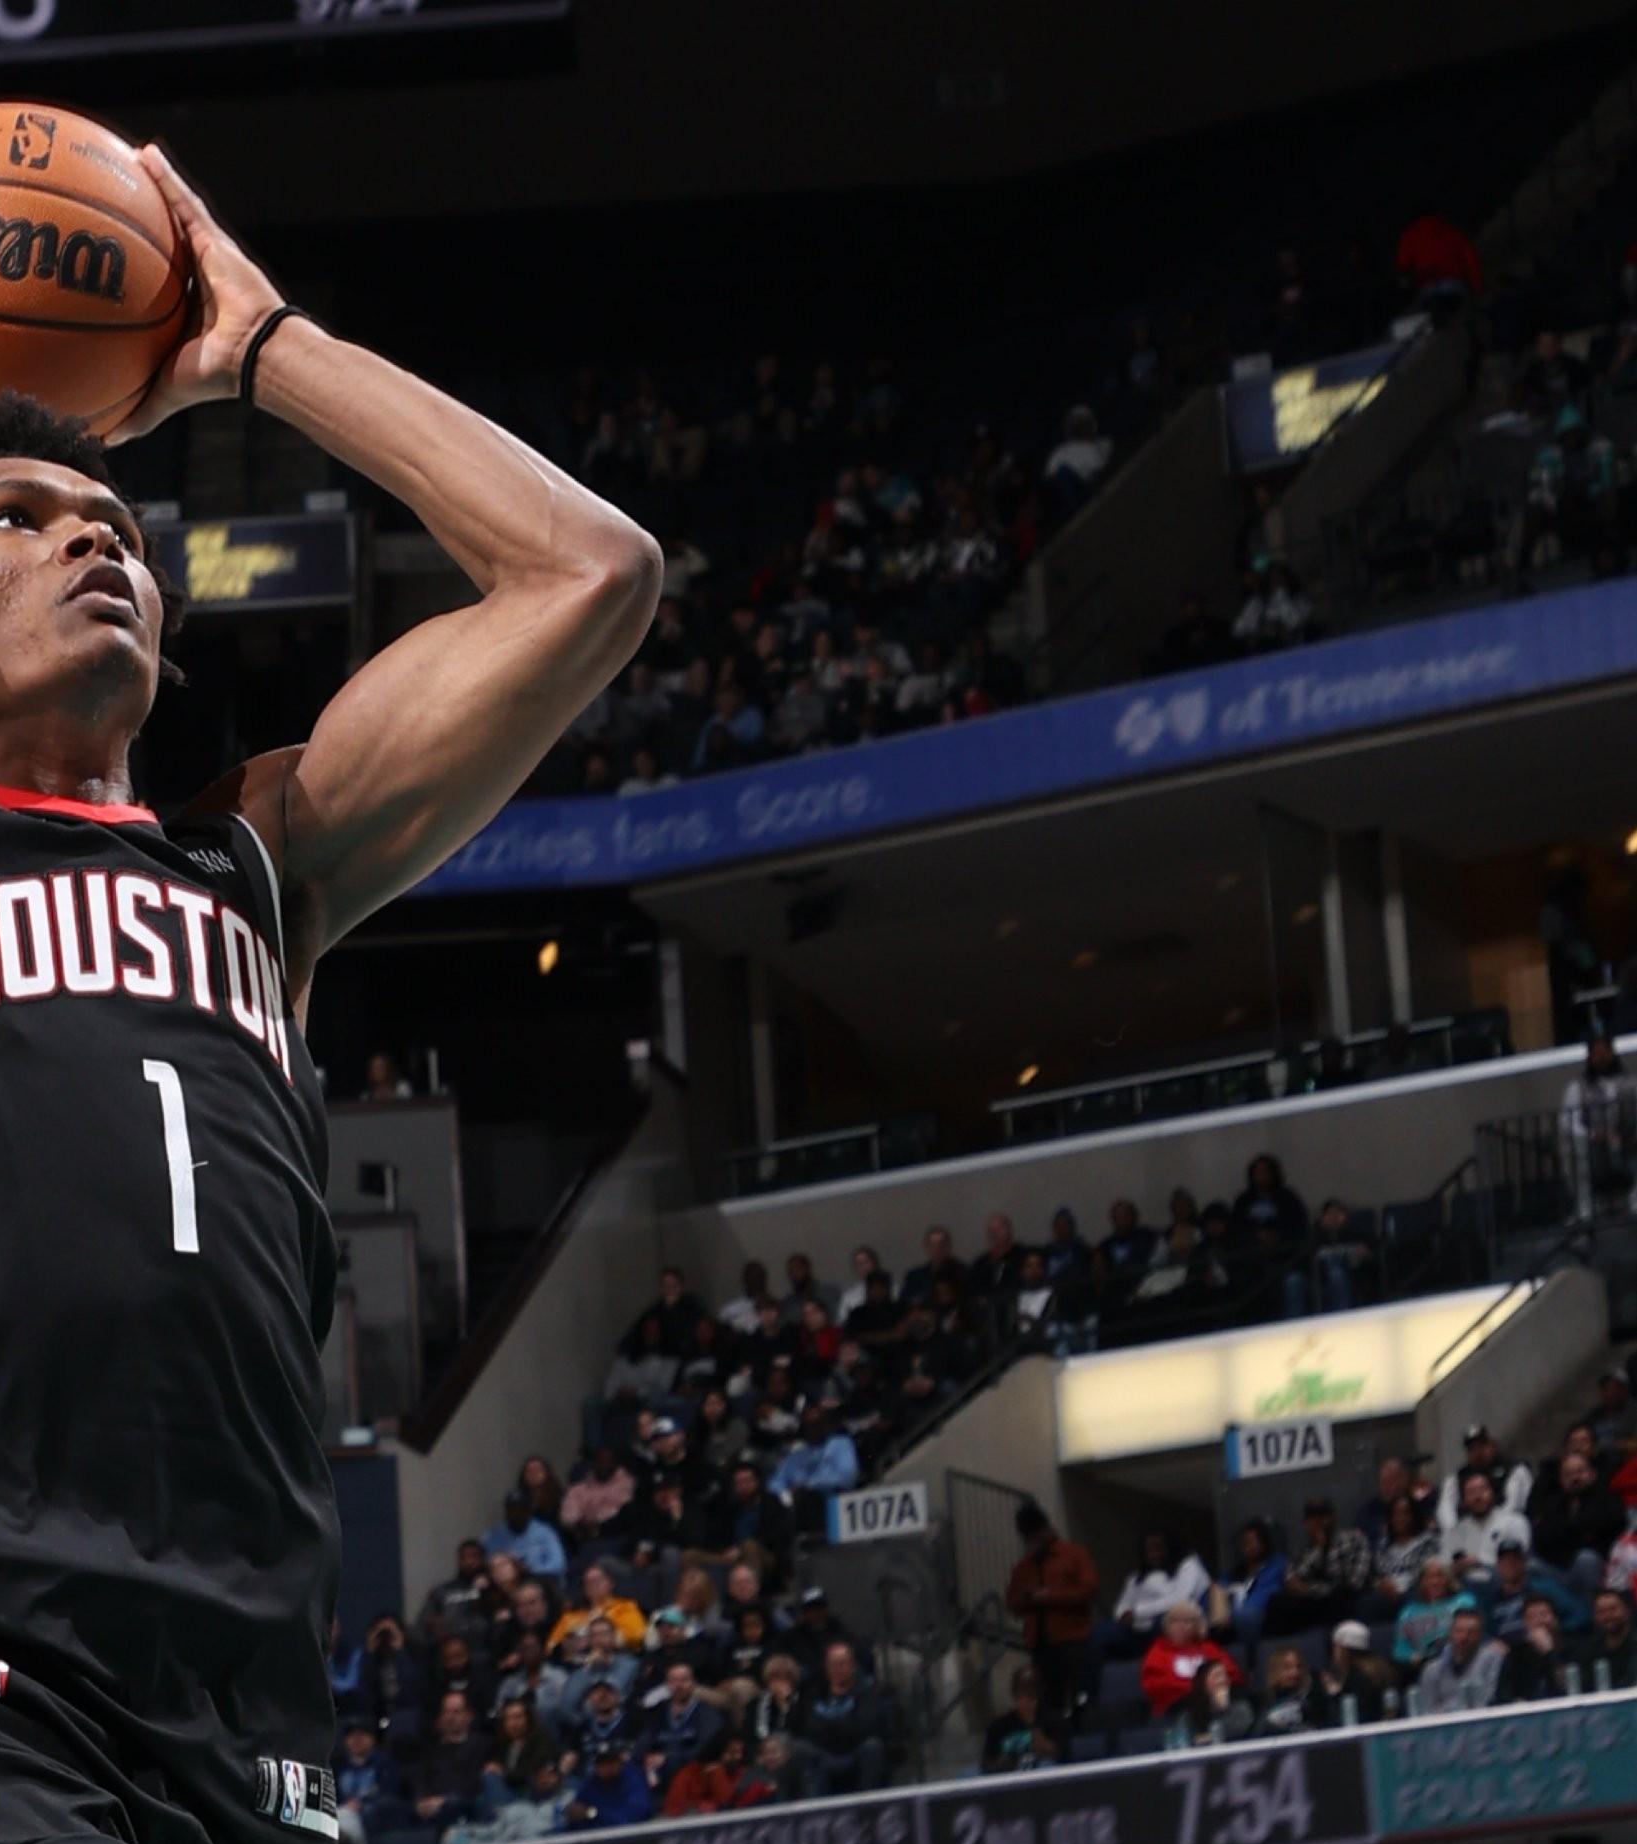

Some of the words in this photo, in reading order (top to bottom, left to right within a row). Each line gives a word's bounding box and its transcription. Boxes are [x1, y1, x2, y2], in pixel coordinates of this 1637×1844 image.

[142, 1058, 201, 1253] 1
[1247, 1423, 1323, 1467] 107A
[846, 1490, 918, 1533] 107A
